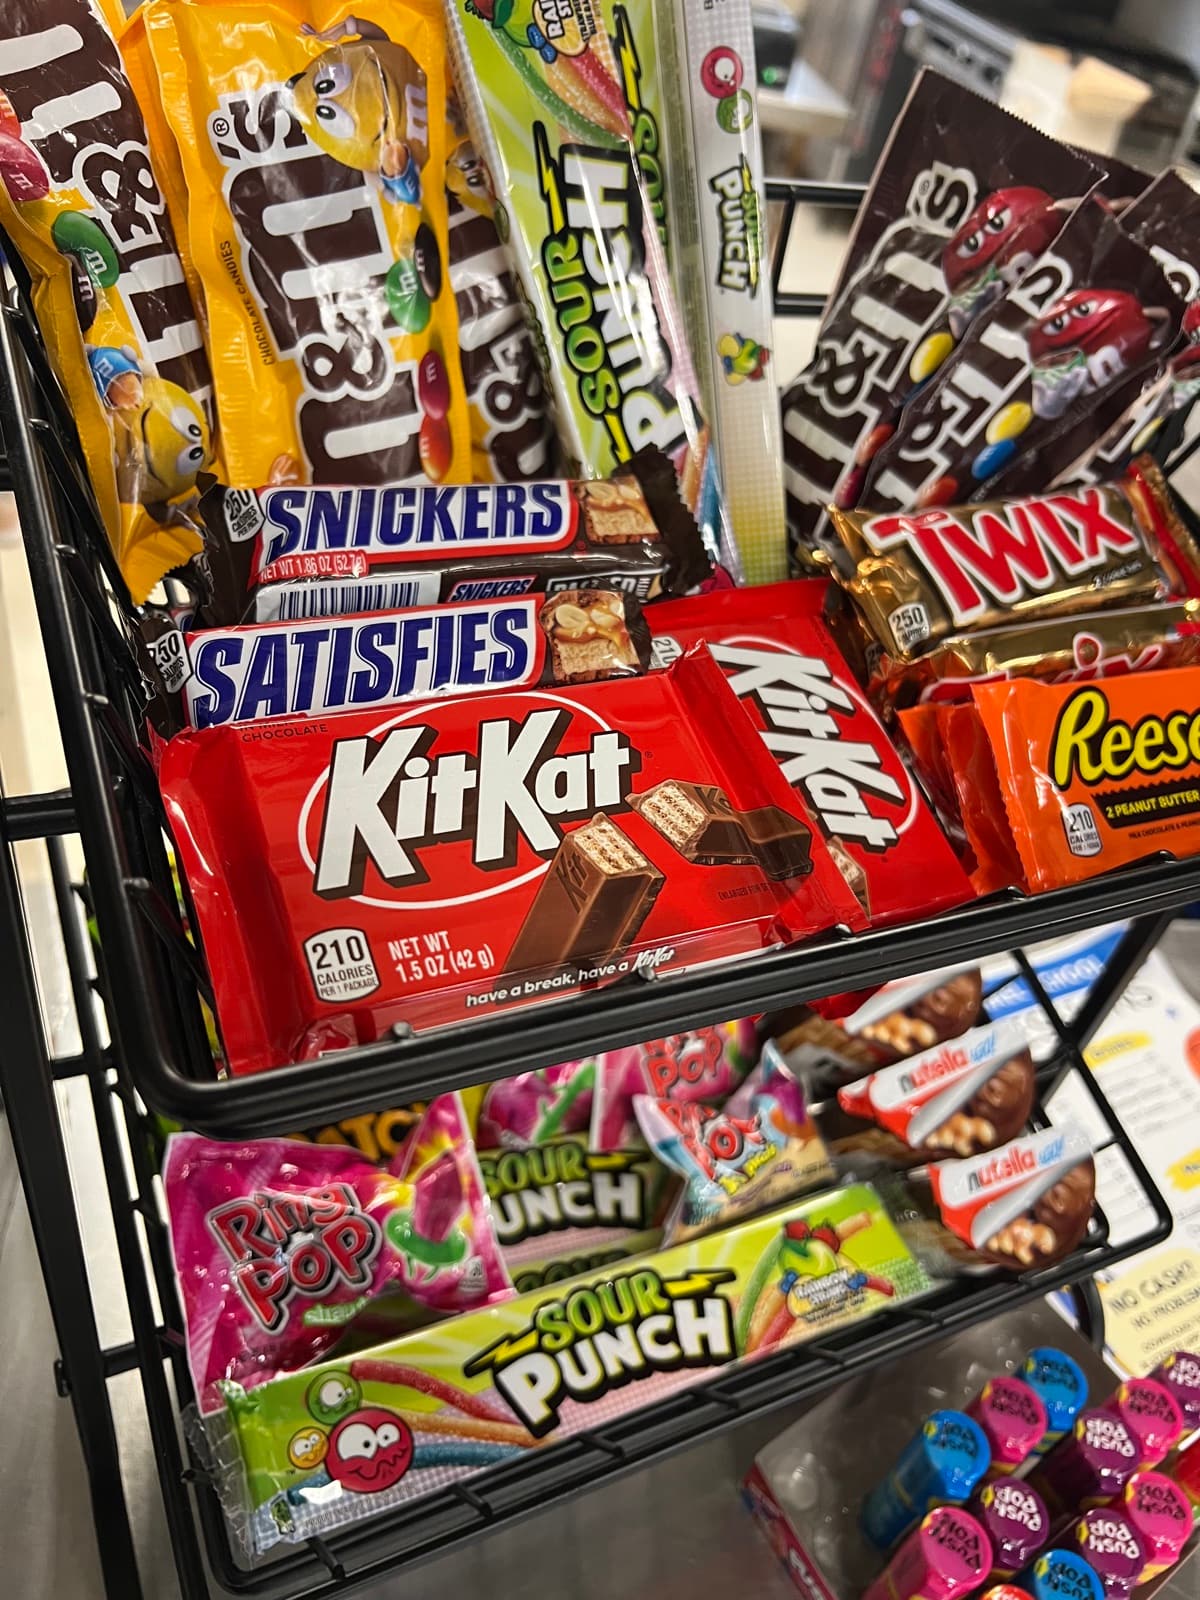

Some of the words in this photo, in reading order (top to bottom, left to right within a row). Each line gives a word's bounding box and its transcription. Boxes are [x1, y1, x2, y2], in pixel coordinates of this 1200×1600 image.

[714, 170, 748, 291] PUNCH
[219, 240, 247, 296] CANDIES
[544, 232, 618, 416] SOUR
[265, 482, 565, 565] SNICKERS
[260, 563, 278, 581] NET
[278, 559, 295, 577] WT
[295, 557, 318, 575] 1.86
[318, 555, 333, 572] OZ
[451, 578, 533, 602] SNICKERS
[892, 607, 924, 632] 250
[194, 607, 529, 728] SATISFIES
[240, 722, 329, 743] CHOCOLATE
[706, 643, 906, 850] KitKat
[315, 708, 632, 893] KitKat
[1069, 809, 1093, 833] 210
[1114, 798, 1158, 817] PEANUT
[1159, 789, 1200, 809] BUTTER
[312, 935, 365, 970] 210
[387, 936, 421, 961] NET
[423, 930, 451, 952] WT
[395, 960, 424, 984] 1.5
[424, 953, 450, 978] OZ
[449, 948, 477, 975] (42
[478, 943, 495, 970] g)
[317, 963, 374, 987] CALORIES
[344, 977, 378, 993] PACKAGE
[466, 988, 507, 1008] have
[510, 986, 522, 997] a
[524, 972, 576, 995] break,
[578, 963, 617, 982] have
[618, 961, 629, 972] a
[631, 945, 676, 972] KitKat
[897, 1045, 970, 1094] nutella
[968, 1147, 1037, 1192] nutella
[210, 1183, 356, 1262] Ring
[497, 1170, 644, 1237] UNCH
[236, 1213, 376, 1326] POP
[537, 1272, 669, 1351] SOUR
[499, 1297, 733, 1429] PUNCH
[1086, 1430, 1136, 1458] PUSH
[993, 1498, 1042, 1532] PUSH
[994, 1486, 1038, 1514] POP
[1088, 1519, 1132, 1541] POP
[1088, 1534, 1140, 1559] PUSH
